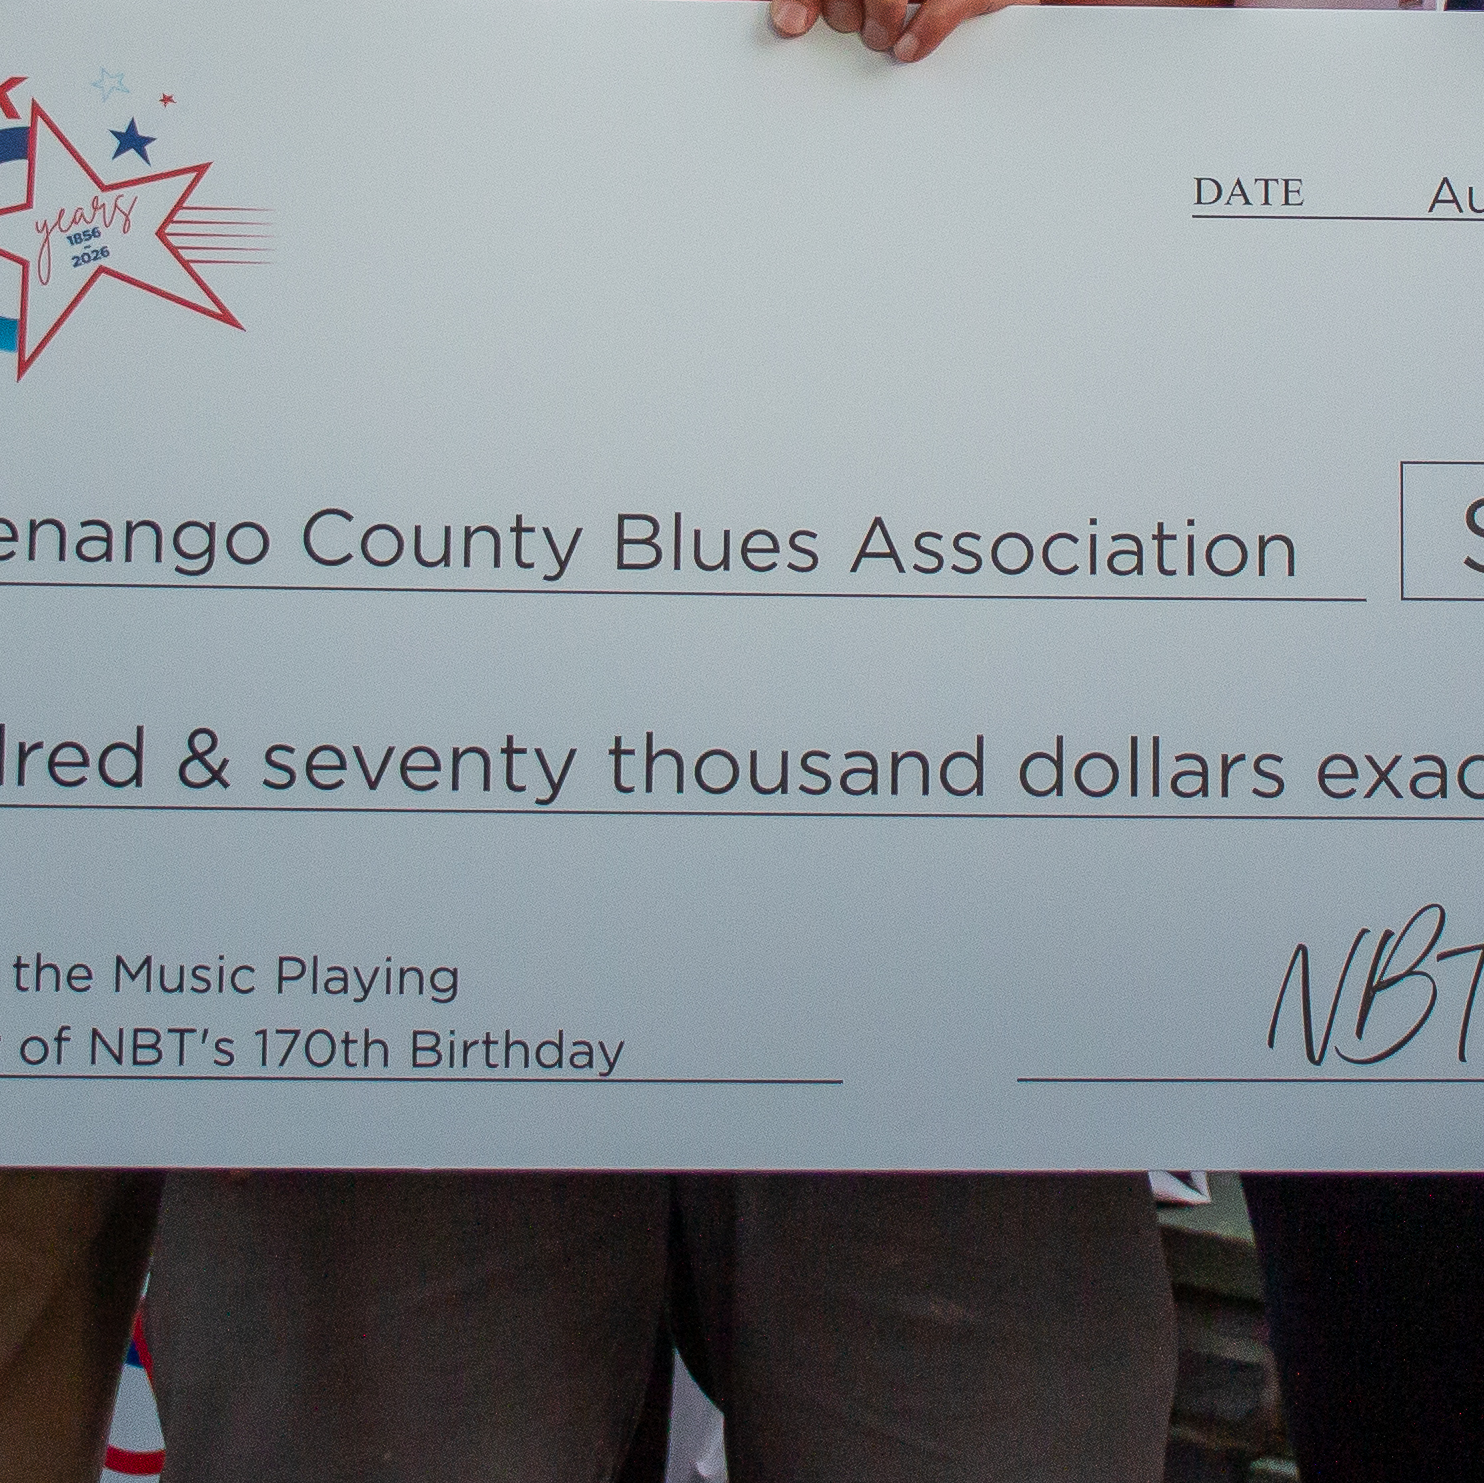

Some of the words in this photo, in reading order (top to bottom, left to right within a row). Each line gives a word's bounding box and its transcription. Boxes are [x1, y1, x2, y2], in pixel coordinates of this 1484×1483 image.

[1195, 177, 1304, 207] DATE
[35, 193, 139, 286] years
[65, 226, 102, 247] 1856
[70, 245, 111, 269] 2026
[302, 508, 583, 583] County
[616, 511, 819, 574] Blues
[849, 516, 1296, 578] Association
[177, 727, 230, 791] &
[262, 734, 577, 807] seventy
[608, 731, 985, 798] thousand
[1019, 735, 1286, 800] dollars
[12, 952, 93, 995] the
[113, 954, 255, 996] Music
[276, 955, 459, 1005] Playing
[18, 1025, 71, 1067] of
[89, 1027, 235, 1068] NBT's
[254, 1028, 389, 1070] 170th
[411, 1029, 625, 1078] Birthday
